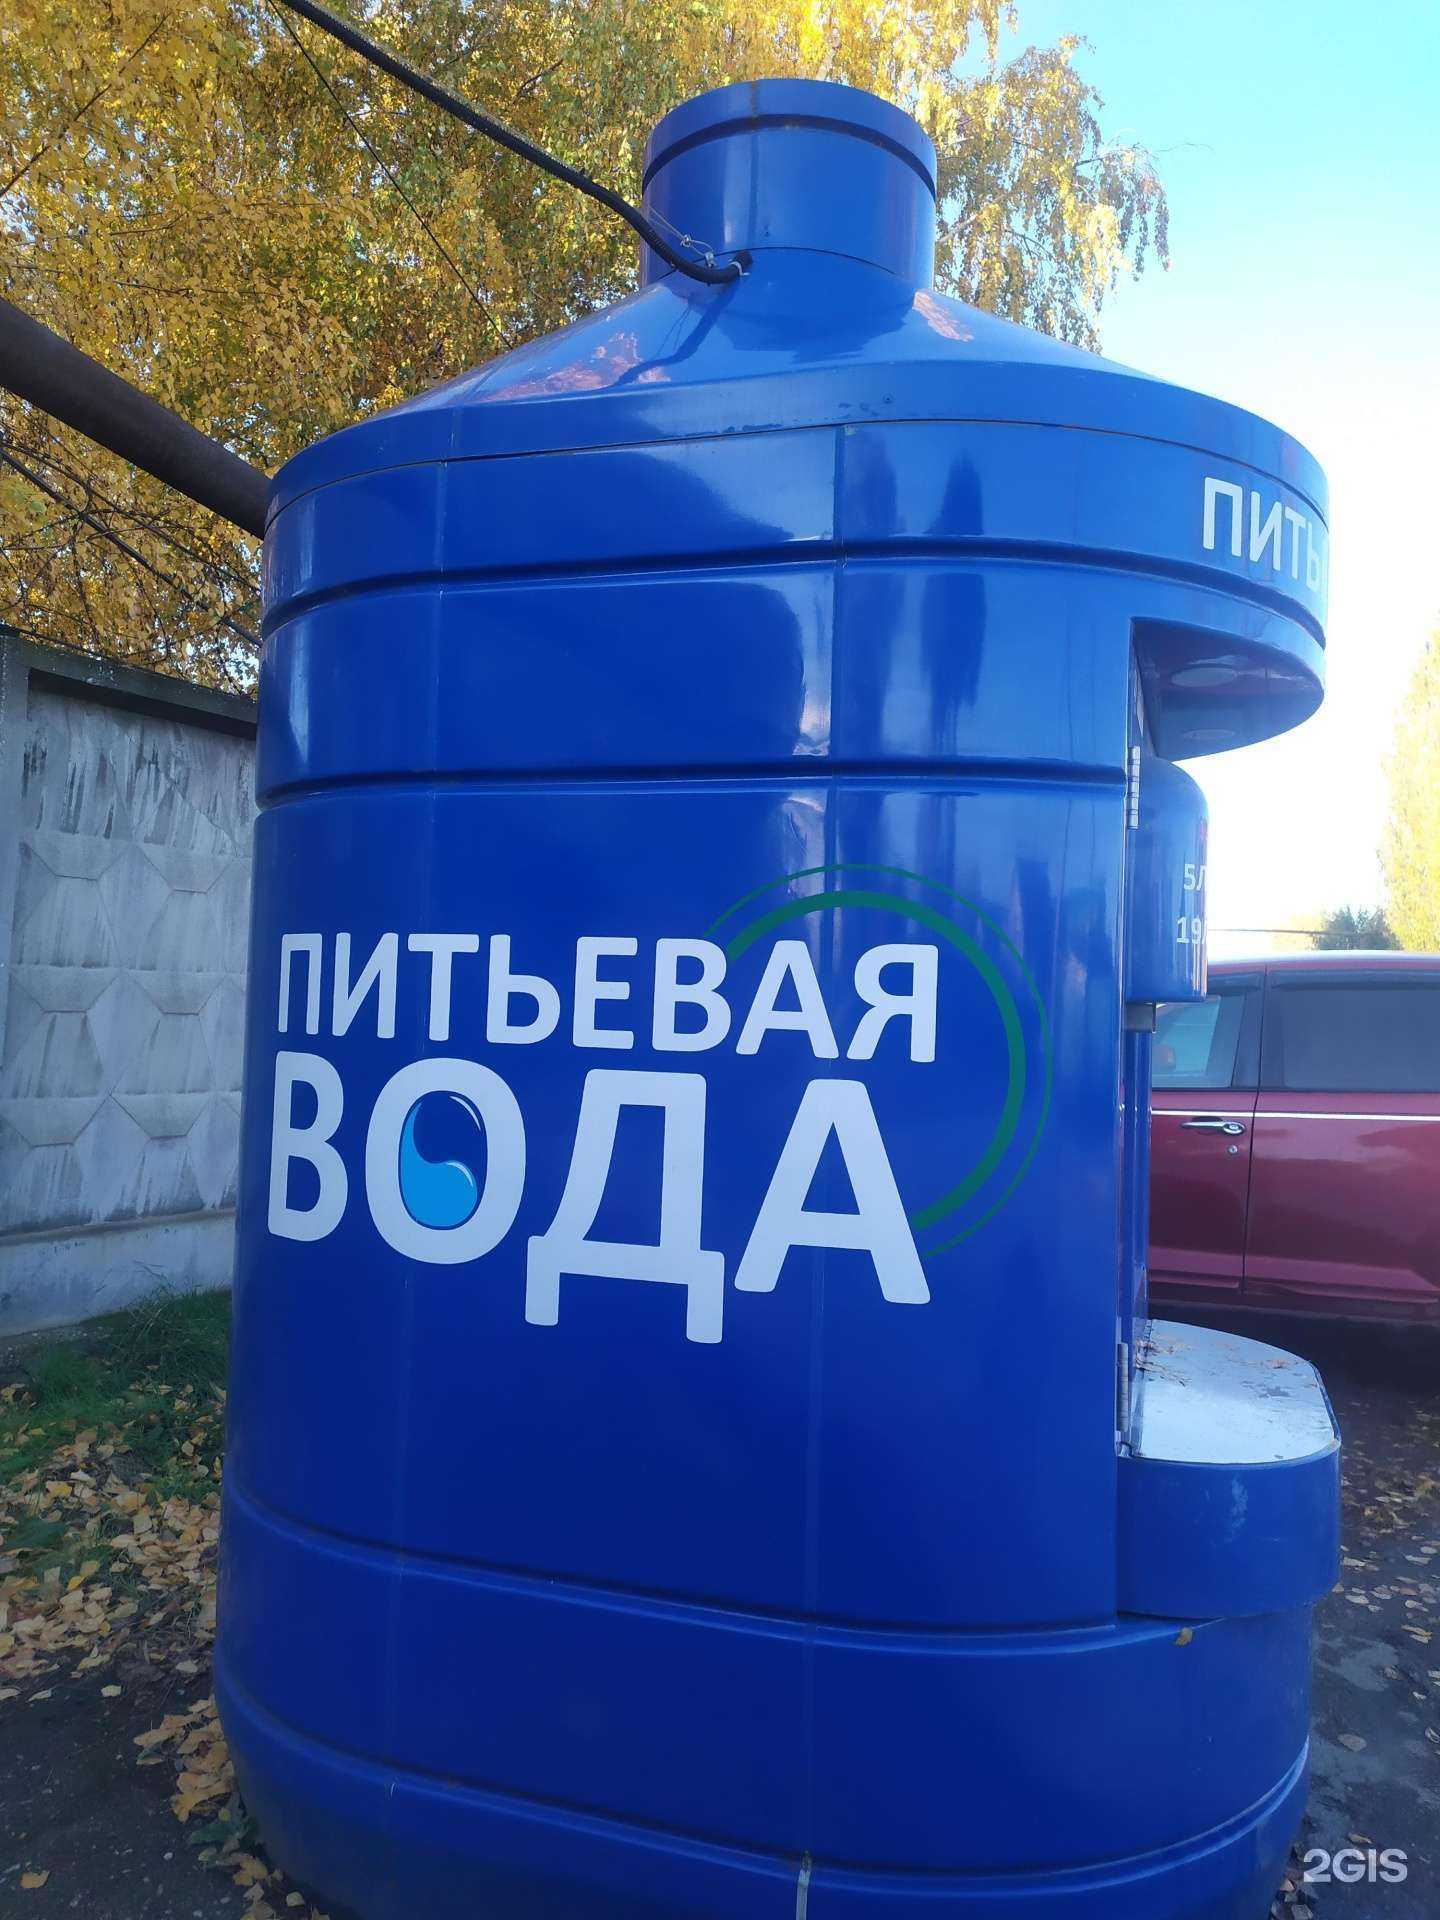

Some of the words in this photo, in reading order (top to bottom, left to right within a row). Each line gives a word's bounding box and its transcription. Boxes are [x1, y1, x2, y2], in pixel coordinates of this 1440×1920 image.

[1203, 476, 1328, 594] ПИТЬ
[278, 932, 939, 1063] ПИТЬЕВАЯ
[267, 1050, 931, 1344] ВОДА
